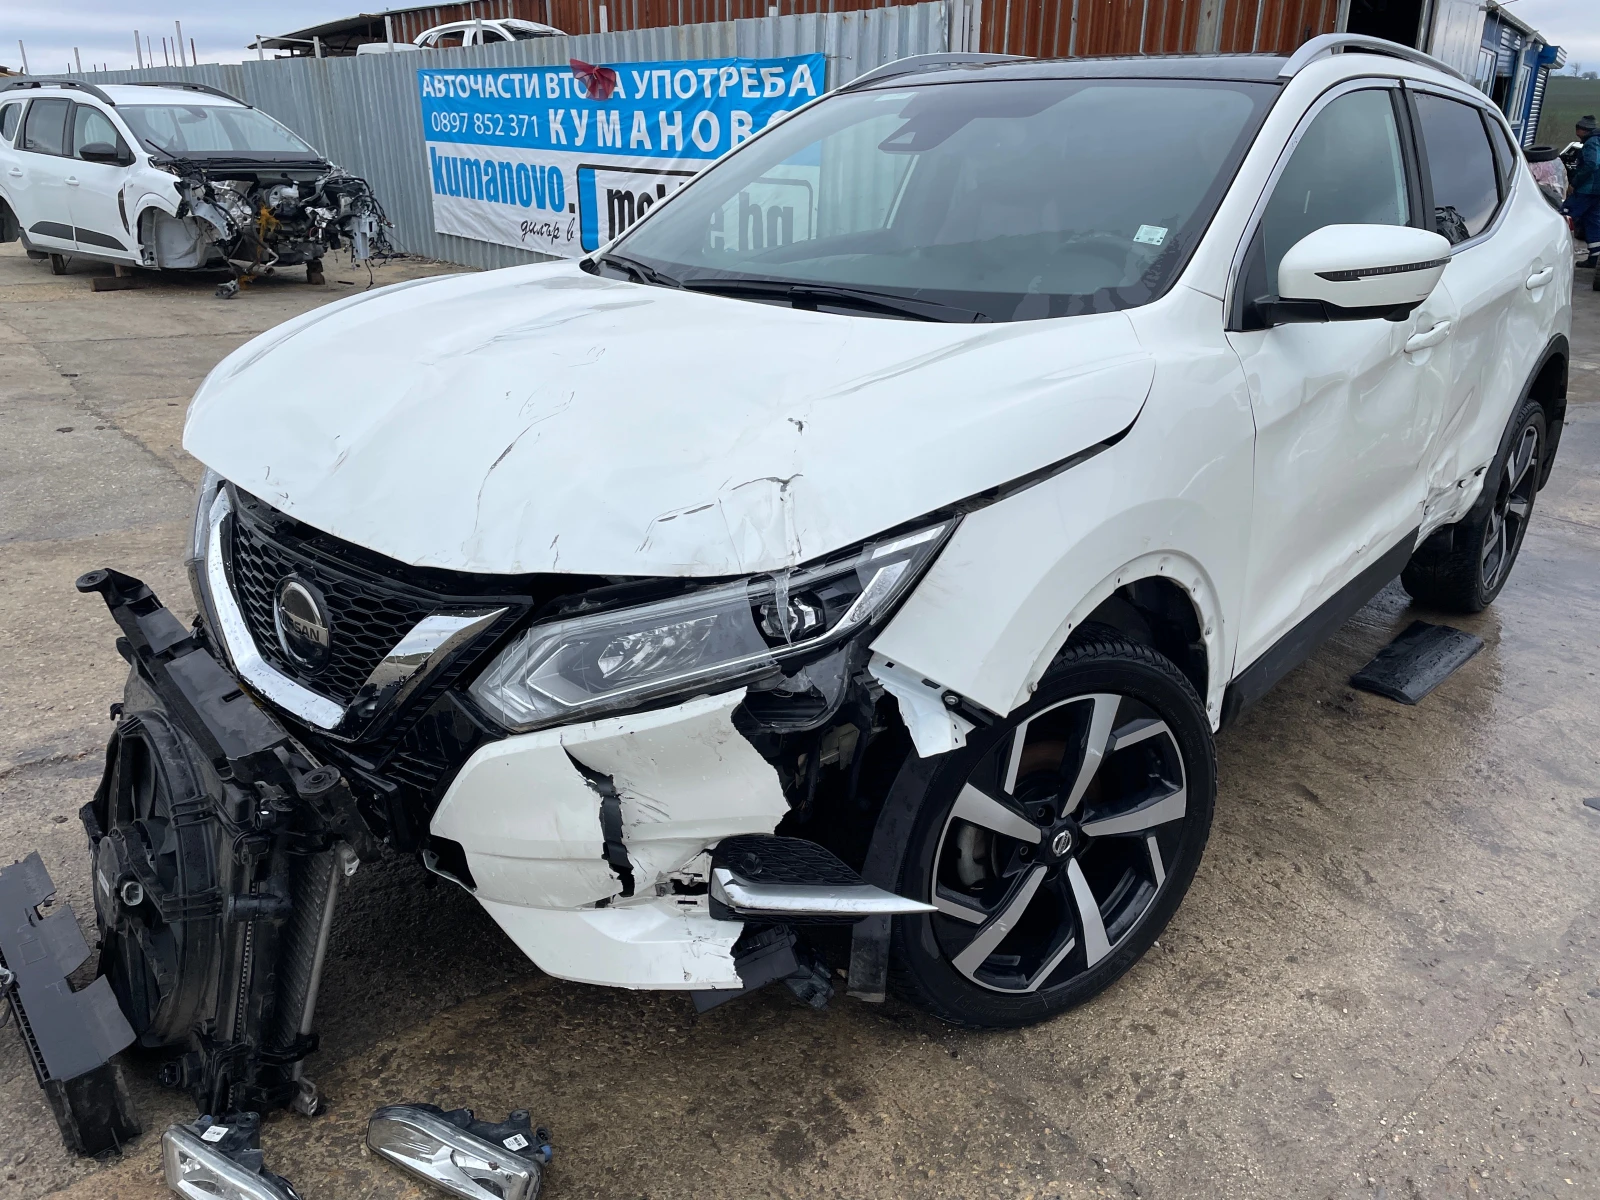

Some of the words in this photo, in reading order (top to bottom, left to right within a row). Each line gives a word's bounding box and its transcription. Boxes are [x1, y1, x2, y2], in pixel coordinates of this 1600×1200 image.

[422, 73, 540, 99] АВТОЧАСТИ
[631, 64, 817, 99] УПОТРЕБА
[431, 111, 468, 133] 0897
[473, 113, 505, 136] 852
[508, 115, 539, 138] 371
[520, 219, 560, 245] дилър
